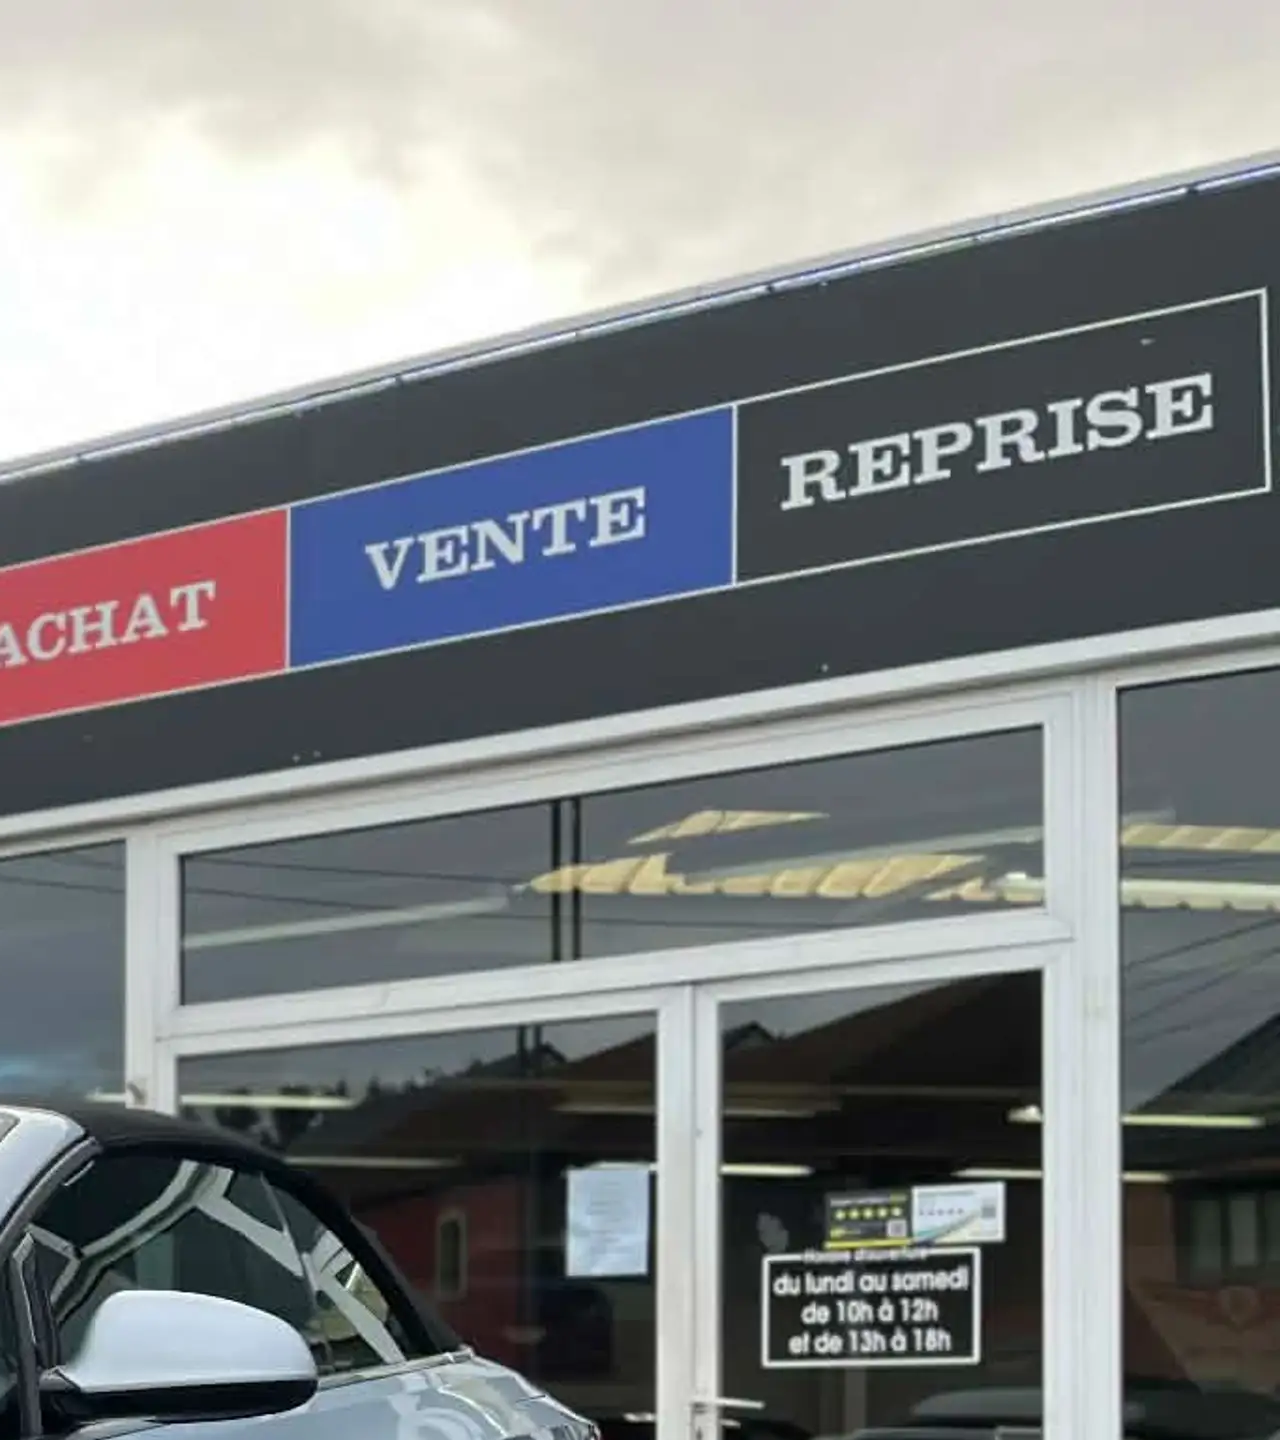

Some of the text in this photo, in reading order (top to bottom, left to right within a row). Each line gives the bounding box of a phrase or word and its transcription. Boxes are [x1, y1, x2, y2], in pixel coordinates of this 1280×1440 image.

[780, 372, 1213, 511] REPRISE
[364, 486, 646, 589] VENTE
[773, 1266, 970, 1296] du lundi au samedi
[801, 1301, 831, 1325] de
[836, 1299, 874, 1324] 10h
[900, 1297, 939, 1322] 12h
[788, 1332, 810, 1355] et
[813, 1331, 844, 1354] de
[848, 1329, 887, 1353] 13h
[913, 1327, 952, 1352] 18h
